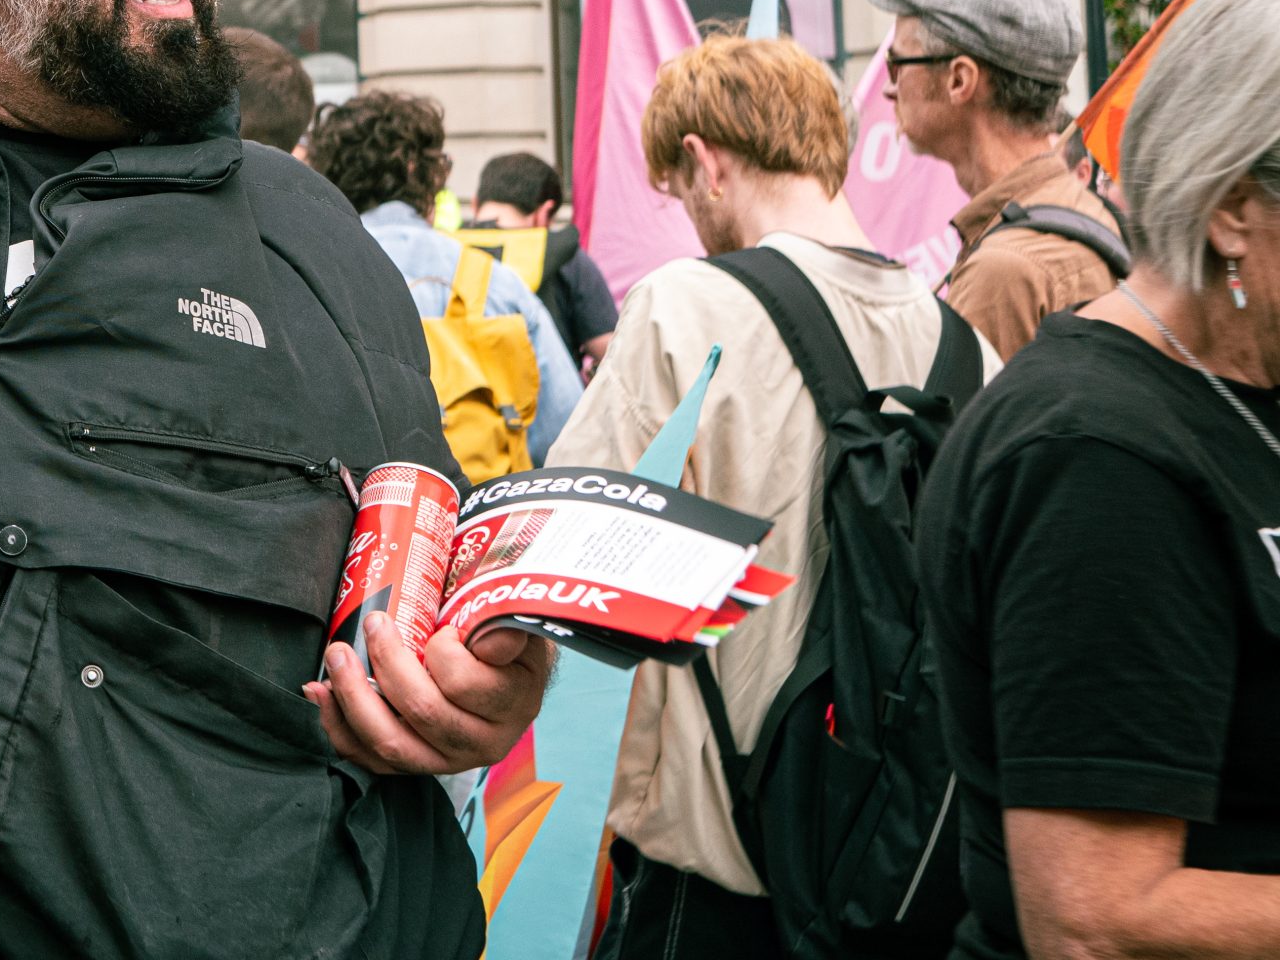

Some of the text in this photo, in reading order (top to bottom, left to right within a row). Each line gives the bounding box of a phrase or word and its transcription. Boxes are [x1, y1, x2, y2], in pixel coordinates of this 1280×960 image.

[200, 287, 232, 310] THE
[177, 298, 234, 326] NORTH
[192, 317, 236, 341] FACE
[459, 475, 668, 517] #GazaCola
